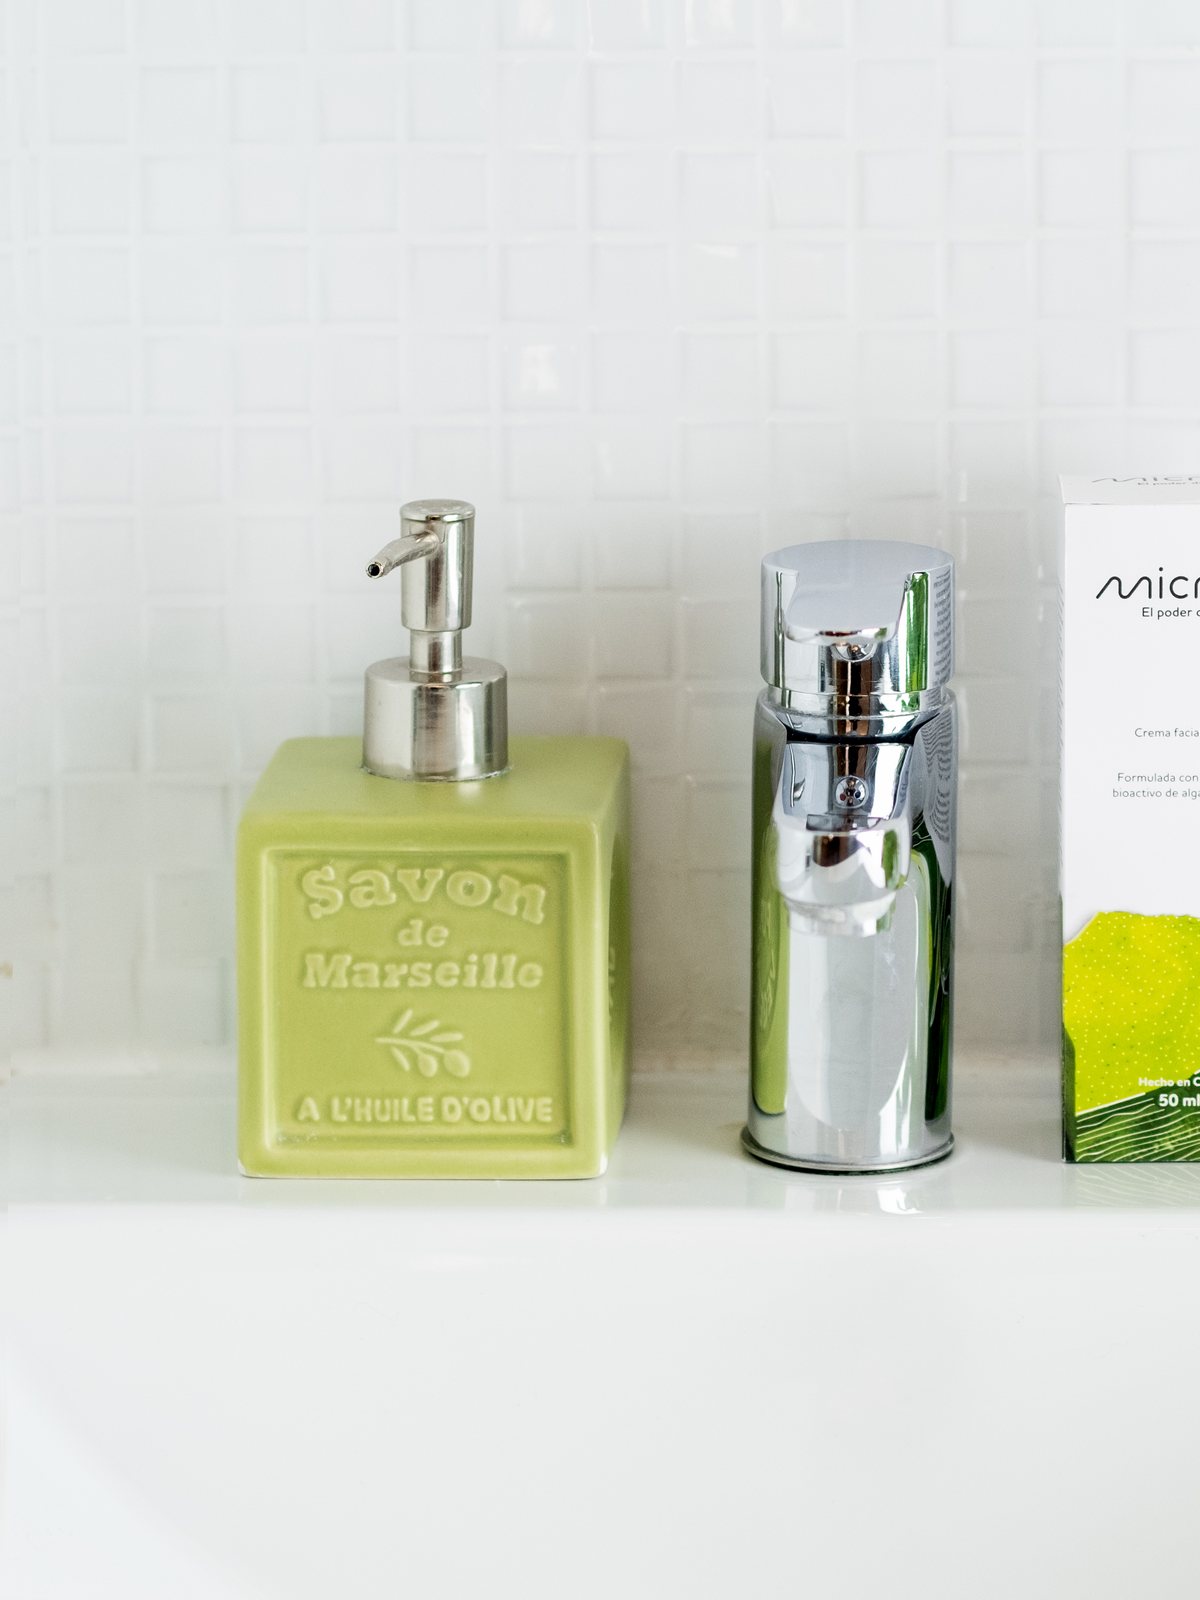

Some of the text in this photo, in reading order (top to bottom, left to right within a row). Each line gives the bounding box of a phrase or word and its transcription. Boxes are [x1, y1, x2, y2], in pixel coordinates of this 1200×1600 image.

[1142, 606, 1153, 617] El
[1157, 606, 1192, 620] poder
[1134, 728, 1171, 737] Crema
[1117, 772, 1176, 782] Formulada
[1179, 774, 1199, 782] con
[1112, 788, 1162, 798] bioactivo
[1165, 788, 1179, 798] de
[301, 865, 546, 924] Savon
[399, 919, 449, 947] de
[302, 953, 543, 989] Marseille
[1138, 1077, 1175, 1087] Hecho
[1176, 1079, 1191, 1087] en
[1158, 1093, 1200, 1107] 50 ml
[297, 1095, 553, 1123] A L'HUILE D'OLIVE
